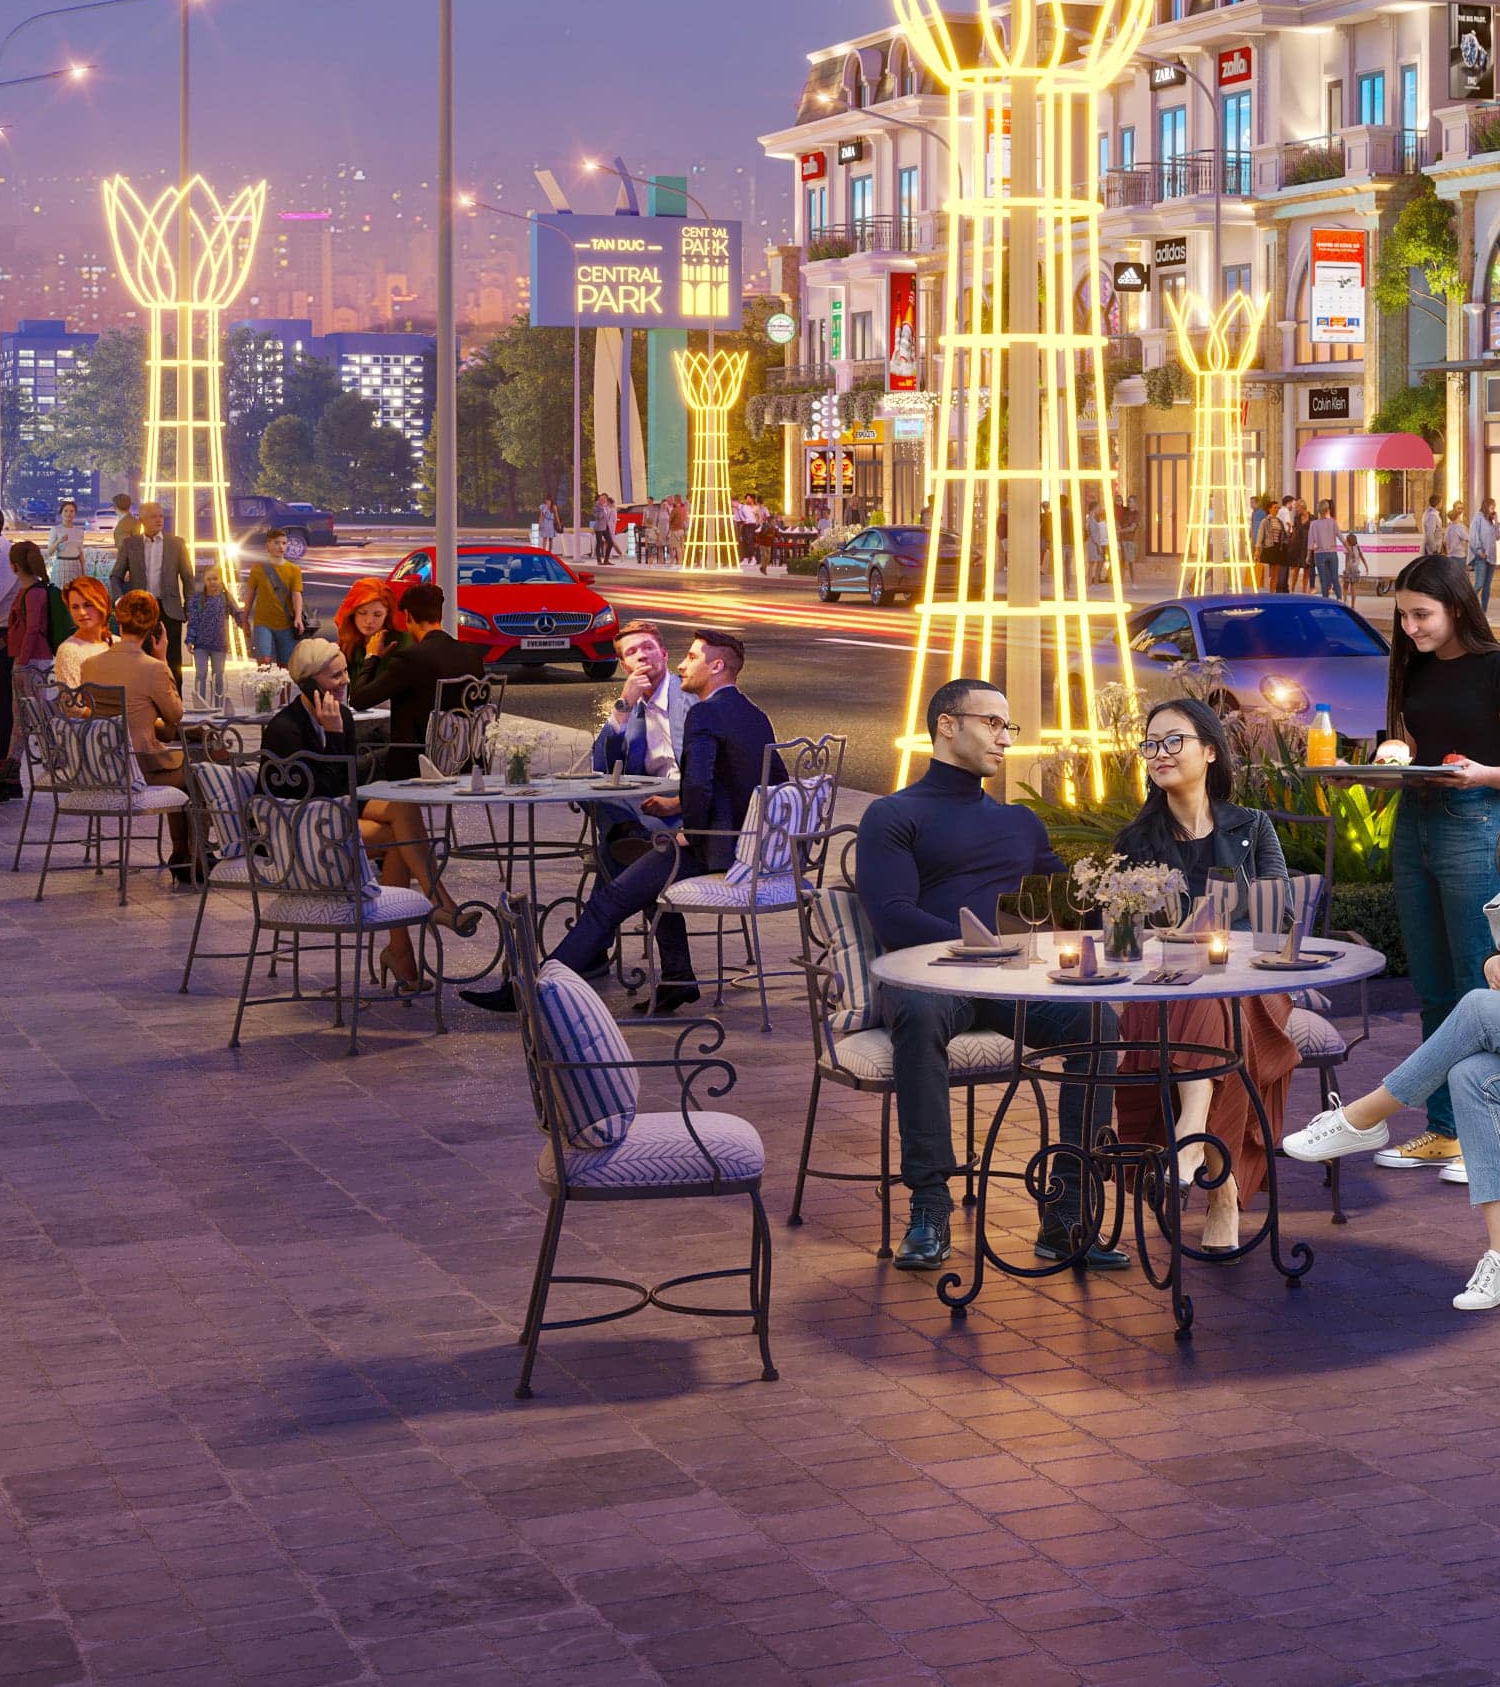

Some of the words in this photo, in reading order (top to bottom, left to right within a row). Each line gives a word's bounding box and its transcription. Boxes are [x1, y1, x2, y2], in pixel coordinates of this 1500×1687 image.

[1154, 66, 1176, 83] ZARA
[681, 226, 729, 239] CENTRAL
[590, 238, 615, 251] TAN
[617, 239, 645, 252] DUC
[681, 238, 729, 257] PARK
[1156, 242, 1186, 264] adidas
[577, 265, 663, 283] CENTRAL
[577, 284, 663, 314] PARK
[1312, 396, 1331, 413] Calvin
[1331, 396, 1347, 411] Klein
[526, 639, 565, 648] EVERMOTION
